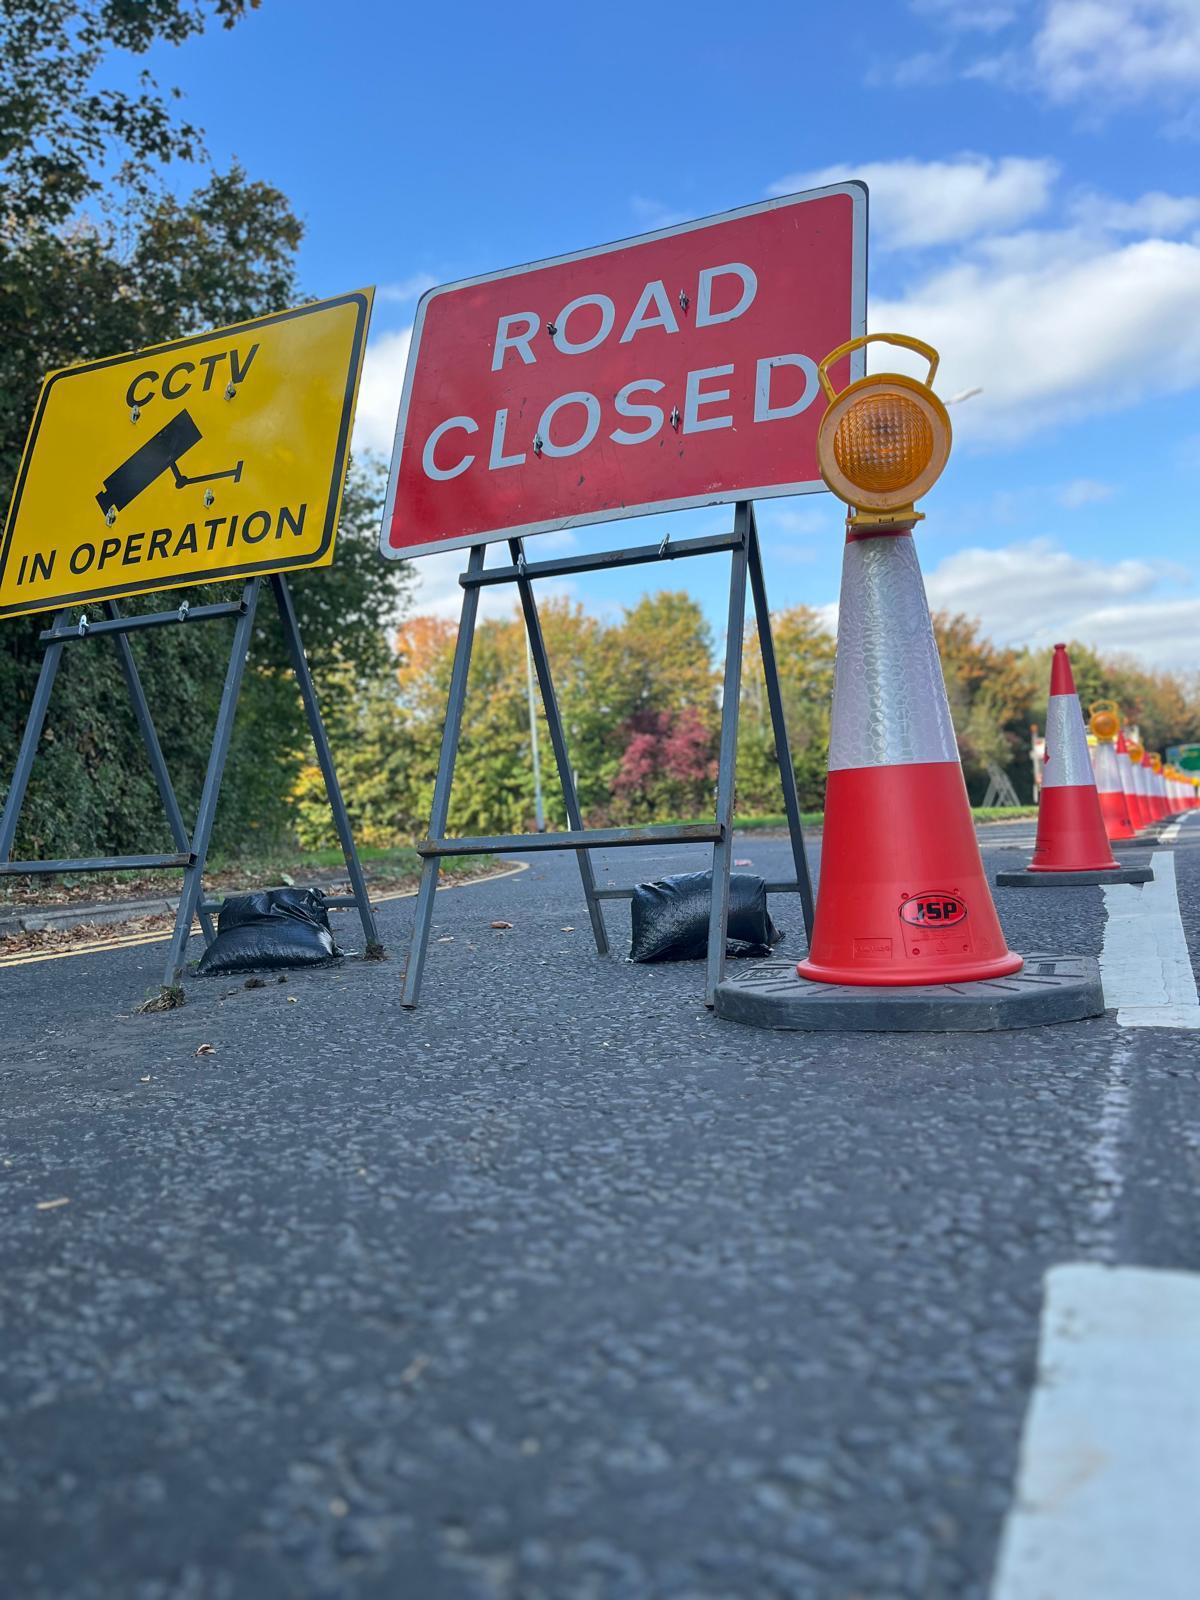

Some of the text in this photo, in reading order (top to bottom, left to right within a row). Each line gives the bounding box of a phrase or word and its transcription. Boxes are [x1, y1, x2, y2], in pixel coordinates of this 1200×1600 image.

[491, 262, 758, 371] ROAD
[125, 343, 260, 408] CCTV
[422, 353, 820, 481] CLOSED
[16, 503, 307, 585] IN OPERATION
[911, 901, 957, 920] JSP
